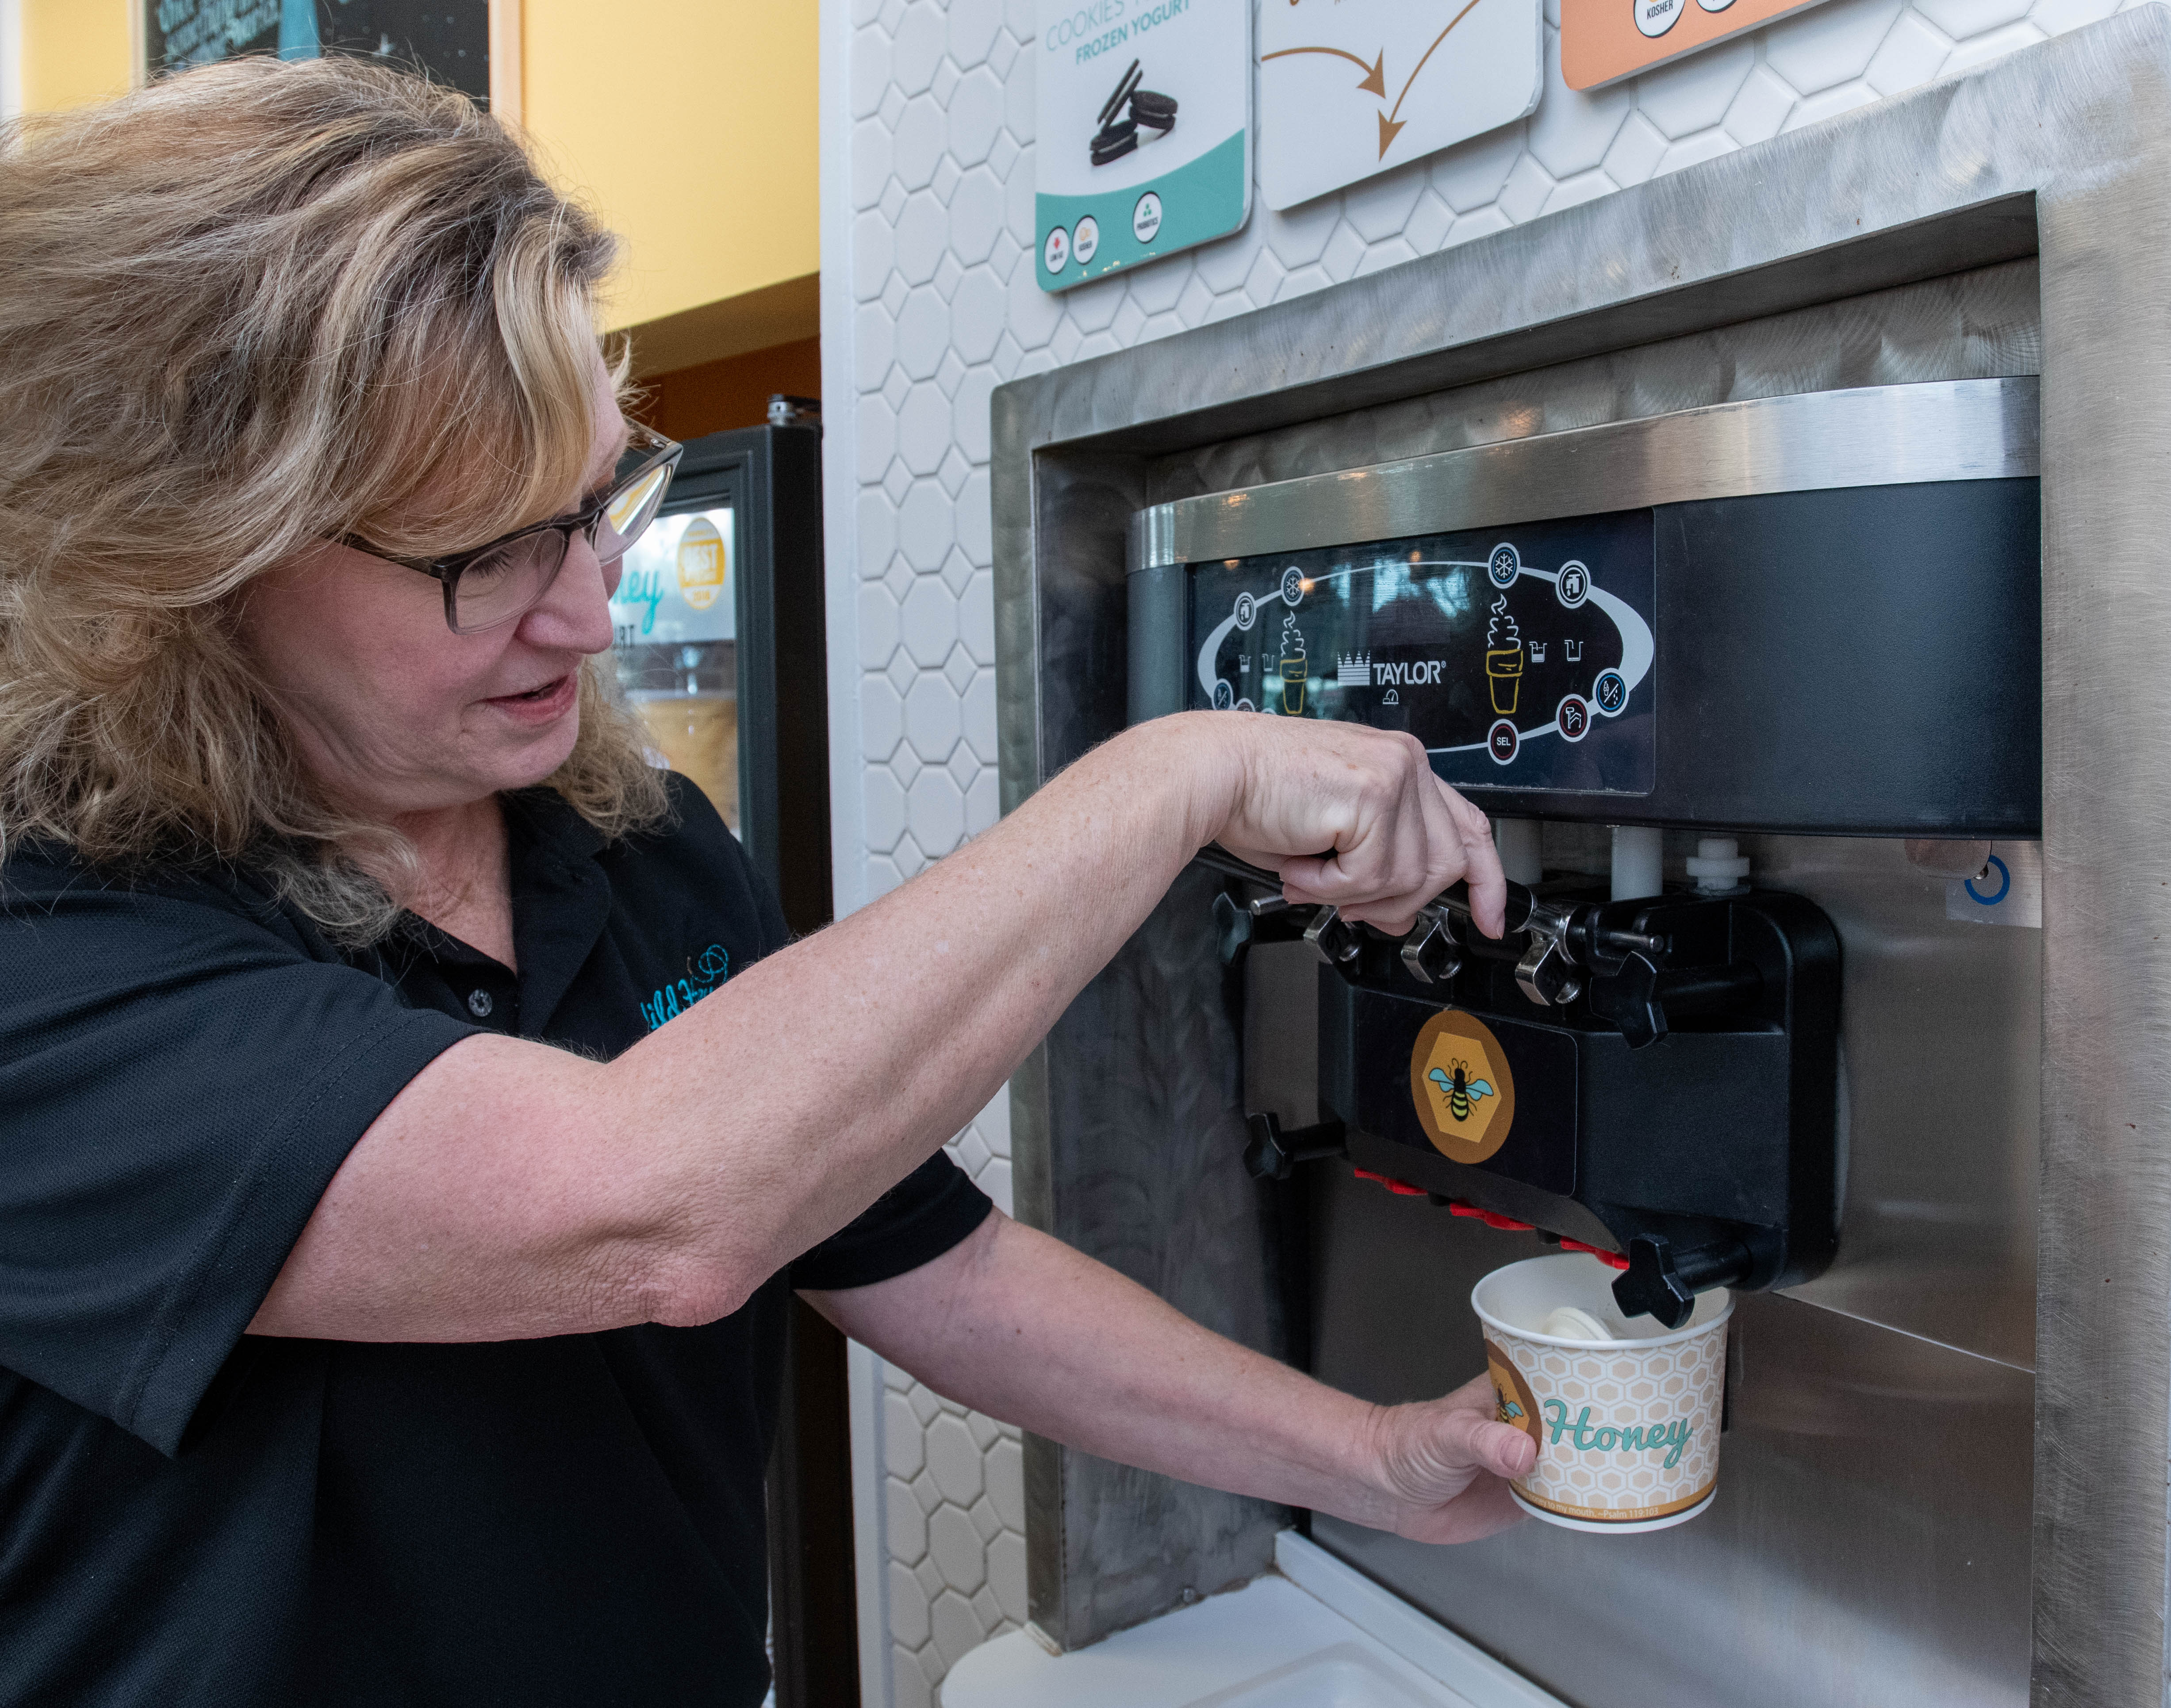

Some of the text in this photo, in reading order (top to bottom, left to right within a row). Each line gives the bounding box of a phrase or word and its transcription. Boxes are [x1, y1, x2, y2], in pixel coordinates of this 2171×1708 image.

[1046, 0, 1125, 51] COOKIES
[1646, 0, 1673, 20] KOSHER
[1075, 23, 1128, 65] FROZEN
[1496, 736, 1511, 746] SEL
[1544, 1398, 1694, 1469] Honey
[1556, 1505, 1568, 1513] my
[1569, 1507, 1596, 1517] mouth.
[1630, 1507, 1659, 1518] 119:103
